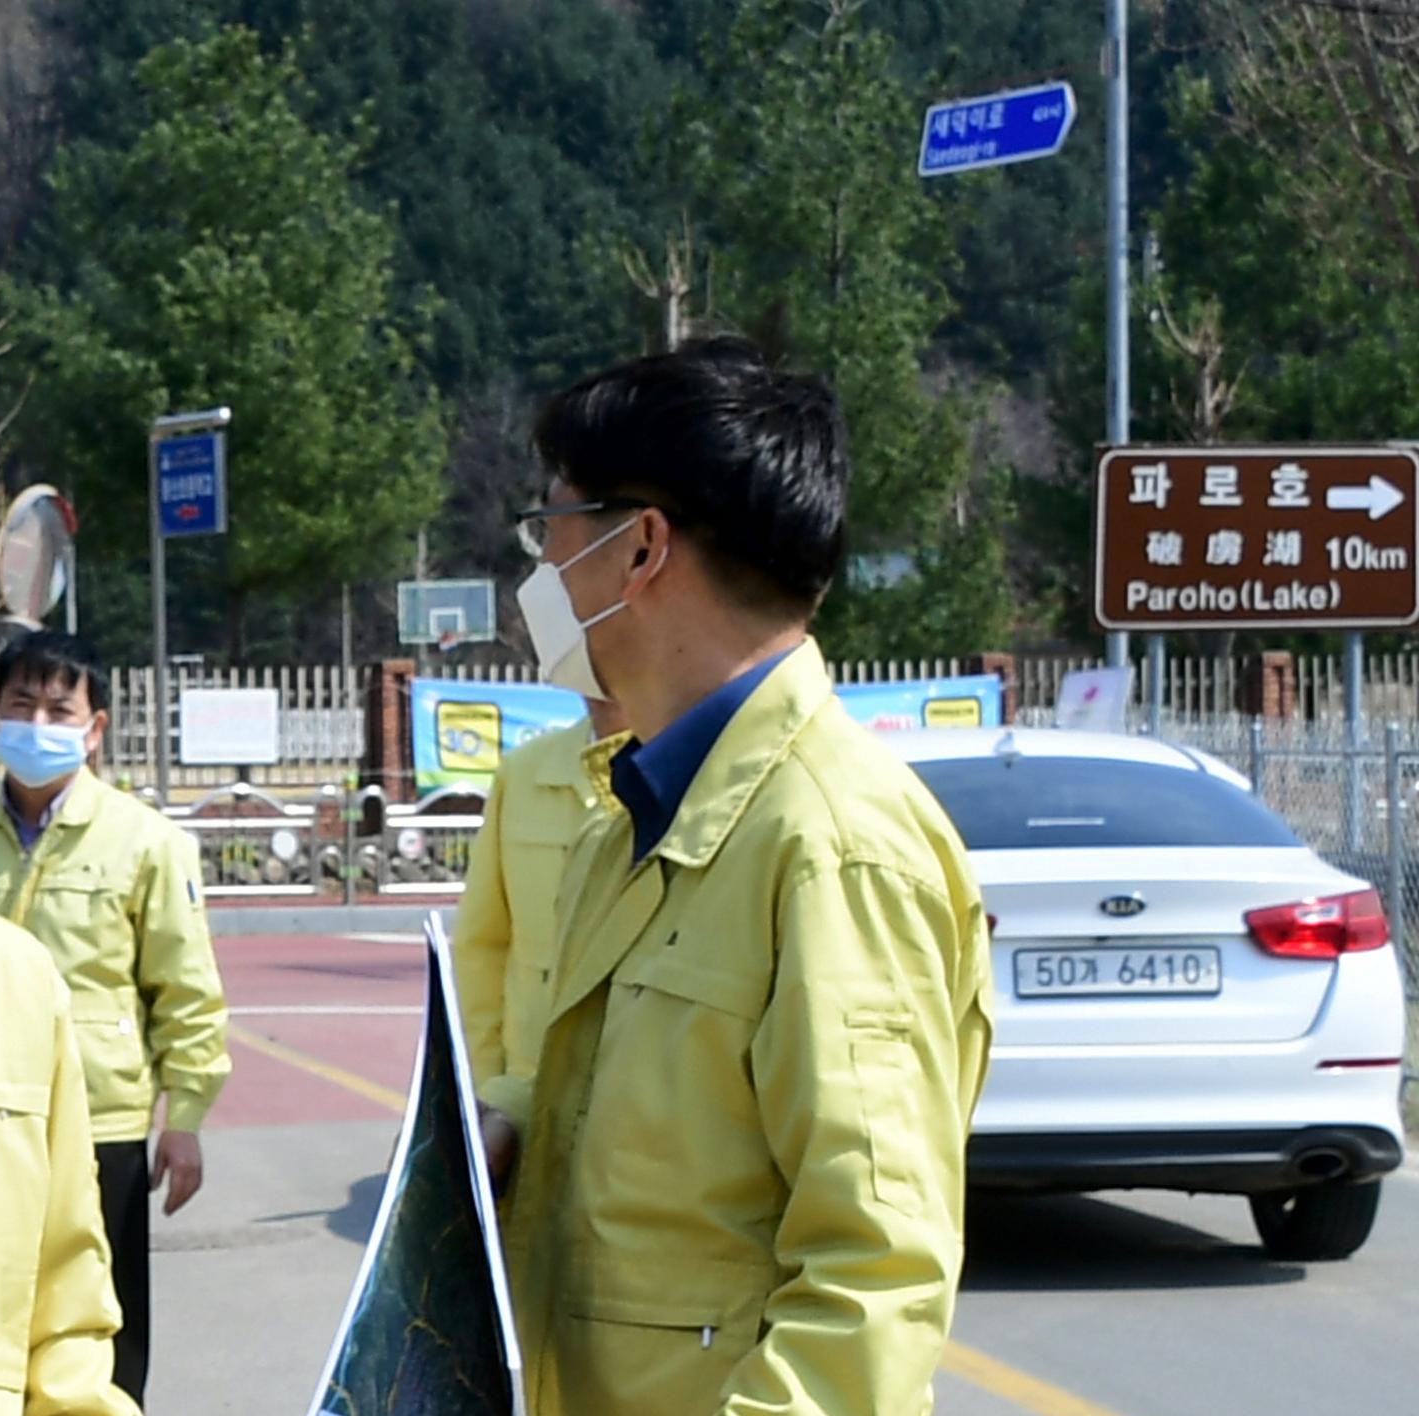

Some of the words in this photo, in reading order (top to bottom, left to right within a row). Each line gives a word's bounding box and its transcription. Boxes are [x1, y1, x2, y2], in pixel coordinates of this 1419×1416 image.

[1325, 536, 1406, 570] 10km
[1126, 578, 1341, 612] Paroho(Lake)
[1118, 954, 1200, 985] 6410
